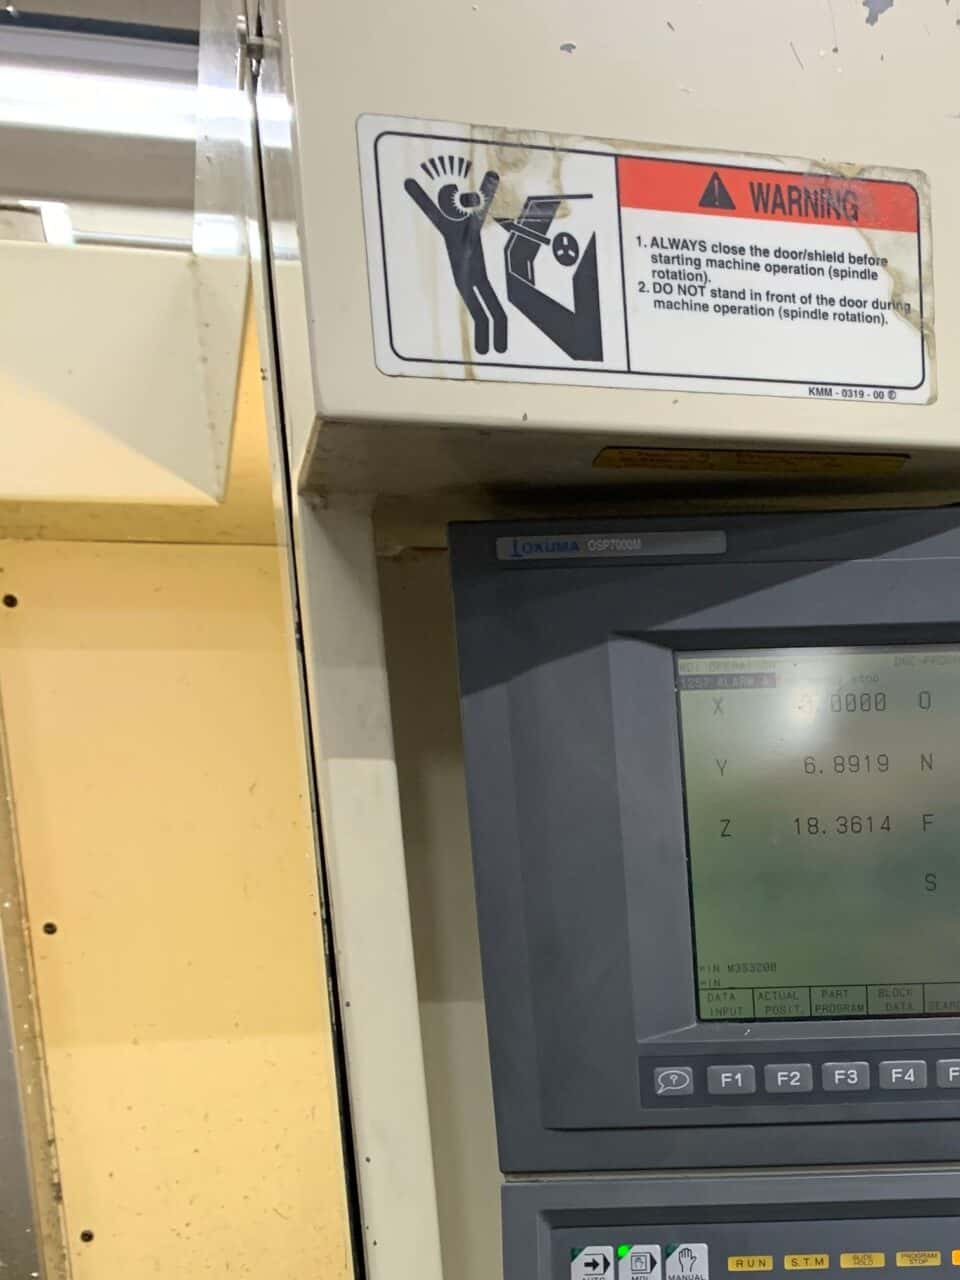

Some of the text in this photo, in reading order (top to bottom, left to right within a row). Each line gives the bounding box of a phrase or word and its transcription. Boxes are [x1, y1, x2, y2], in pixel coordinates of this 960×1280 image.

[749, 182, 858, 221] WARNING
[636, 236, 888, 267] 1. ALWAYS close the door/shield before
[650, 254, 878, 282] starting machine operation (spindle
[651, 269, 712, 285] rotation).
[638, 281, 911, 314] 2. DO NOT stand in front of the door during
[653, 298, 889, 326] machine operation (spindle rotation).
[808, 387, 832, 397] KMM
[712, 697, 724, 715] X
[716, 758, 728, 777] Y
[803, 753, 889, 776] 6.8919
[919, 752, 934, 772] N
[719, 818, 732, 838] Z
[793, 814, 893, 837] 18.3614
[921, 813, 934, 833] F
[923, 872, 938, 893] S
[720, 1072, 743, 1089] F1
[776, 1071, 801, 1087] F2
[834, 1069, 859, 1085] F3
[891, 1068, 916, 1084] F4
